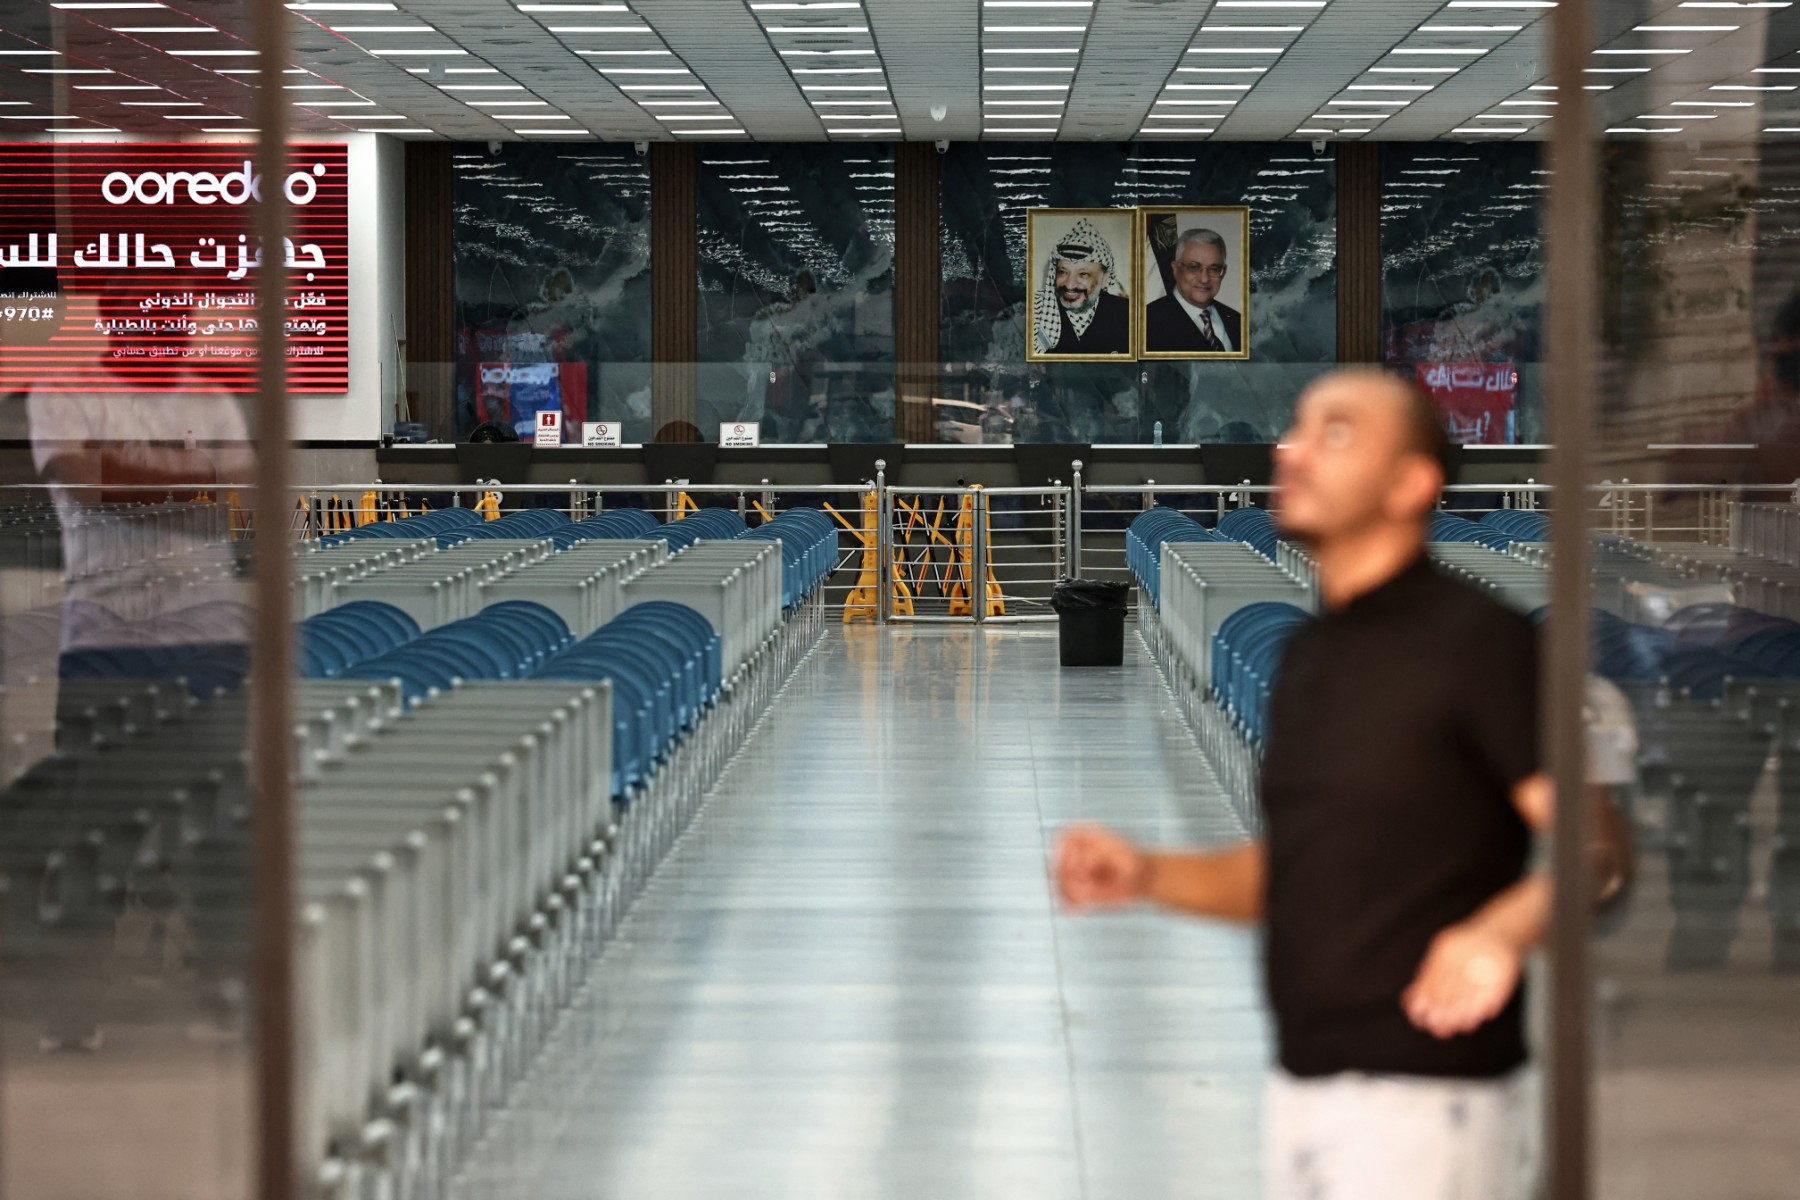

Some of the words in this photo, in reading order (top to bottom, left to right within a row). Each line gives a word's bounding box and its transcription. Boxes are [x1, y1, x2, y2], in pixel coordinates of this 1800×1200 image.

[73, 233, 176, 268] حالك
[140, 292, 193, 312] الدولي
[198, 292, 255, 309] التجوال
[95, 318, 157, 335] بالطيارة
[162, 315, 197, 335] وأنت
[202, 318, 234, 335] حتى
[283, 318, 327, 336] وتمتع
[113, 346, 145, 359] حسابي
[149, 346, 179, 357] تطبيق
[182, 347, 195, 357] من
[199, 344, 208, 357] أو
[211, 346, 242, 357] موقعنا
